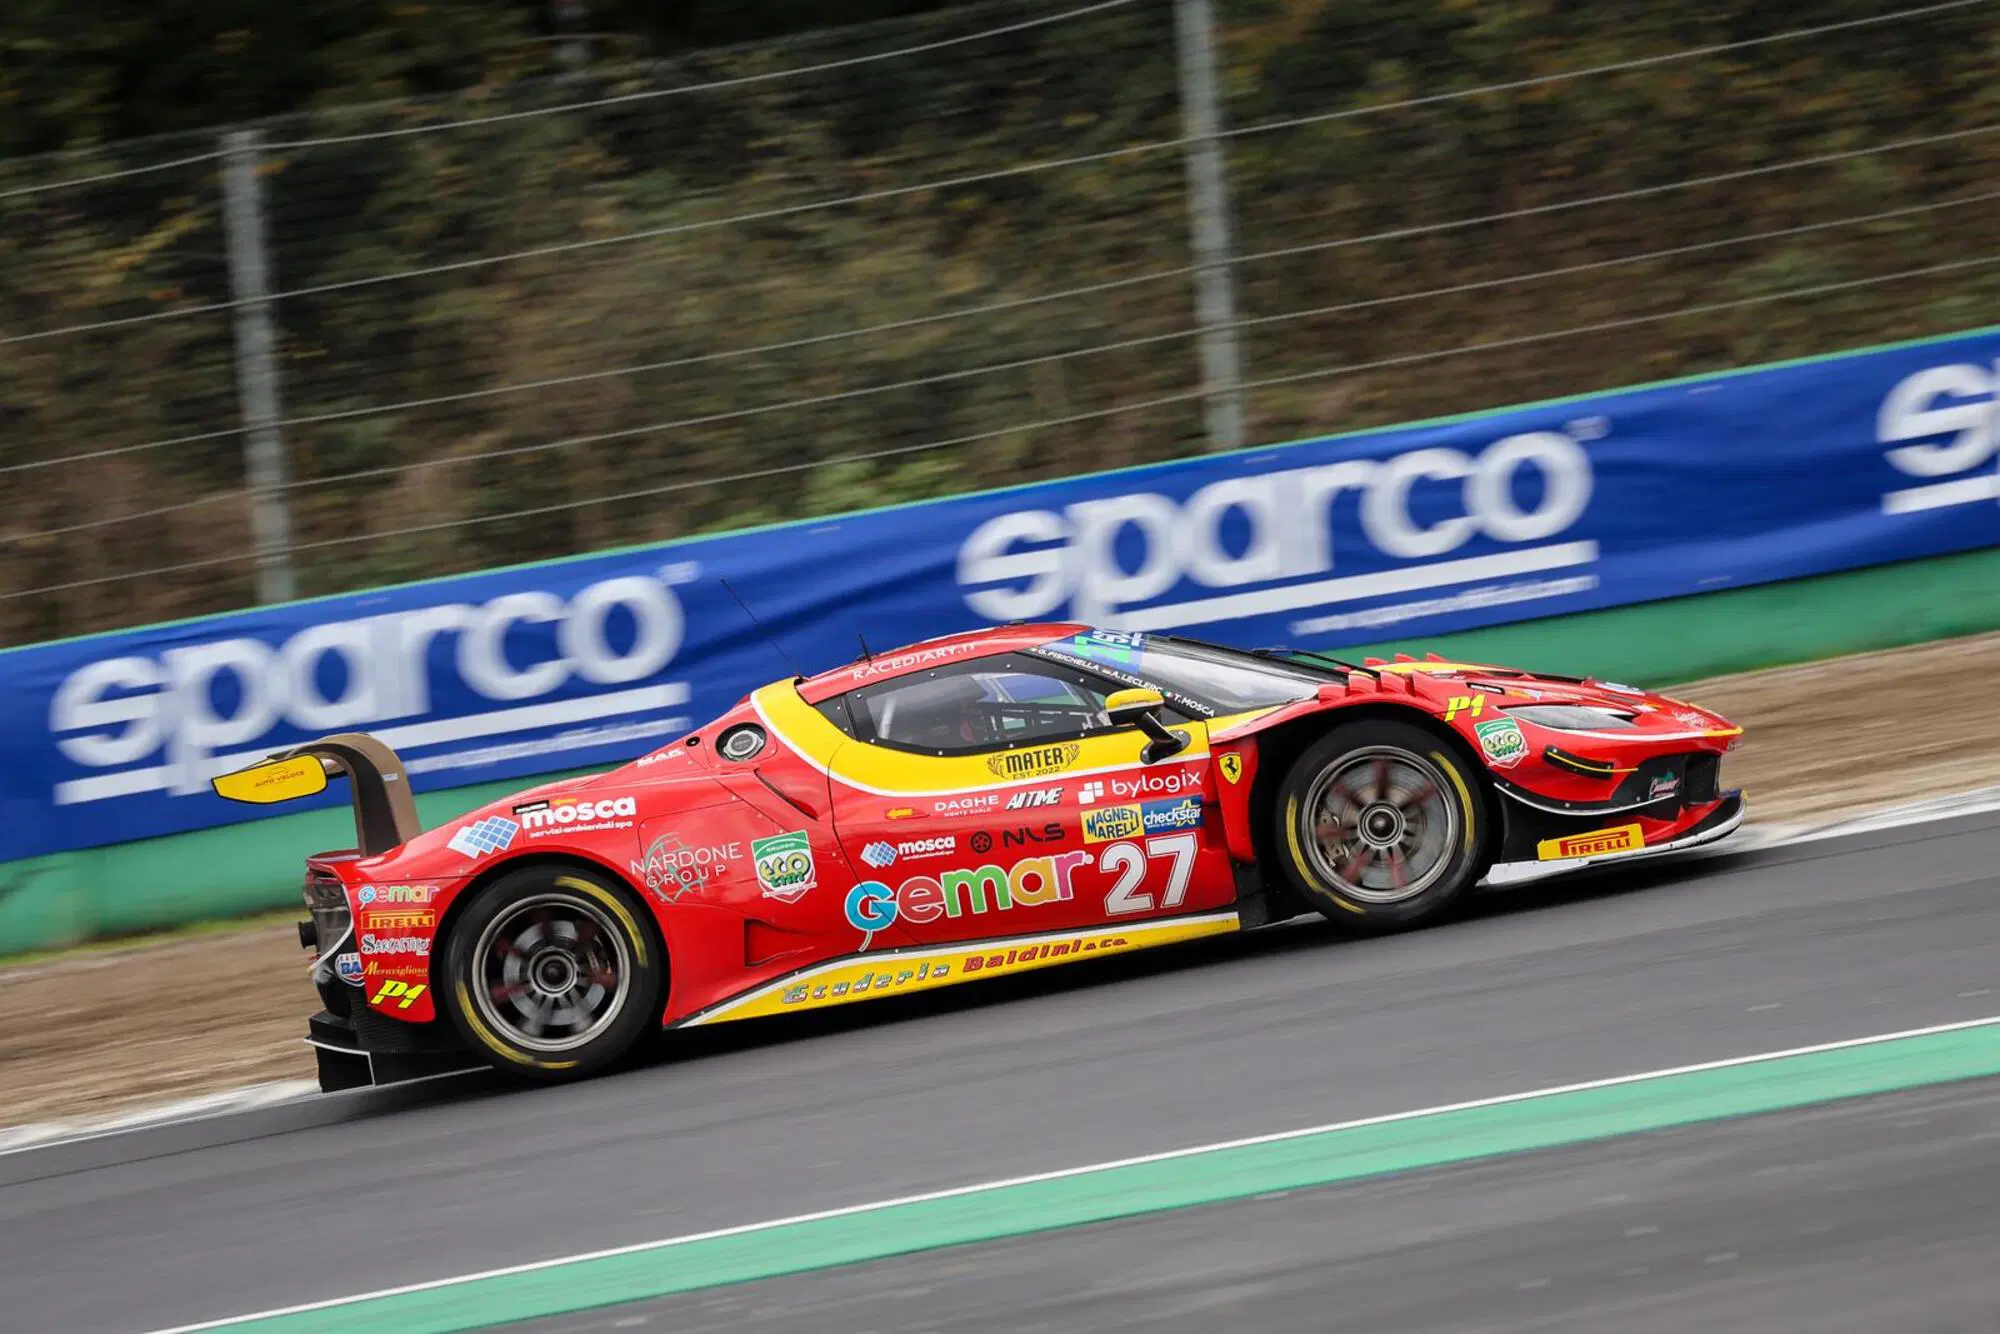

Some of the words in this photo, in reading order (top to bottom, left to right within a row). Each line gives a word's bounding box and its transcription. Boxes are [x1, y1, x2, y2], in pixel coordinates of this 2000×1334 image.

[956, 431, 1594, 631] sparco
[49, 575, 686, 796] sparco
[1445, 694, 1486, 722] P1
[1006, 747, 1063, 773] MATER
[1036, 766, 1060, 776] 2022
[1111, 768, 1201, 798] bylogix
[522, 797, 637, 829] mosca
[934, 795, 999, 811] DAGHE
[1143, 807, 1202, 825] checkstar
[1086, 808, 1139, 833] MAGNETI
[1086, 817, 1139, 839] MARELLI
[898, 835, 956, 855] mosca
[1559, 831, 1630, 857] PIRELLI
[630, 842, 744, 875] NARDONE
[646, 864, 726, 888] GROUP
[1099, 832, 1198, 916] 27
[361, 909, 435, 929] PIRELLI
[370, 979, 428, 1009] P1
[786, 961, 951, 1002] Scuderia
